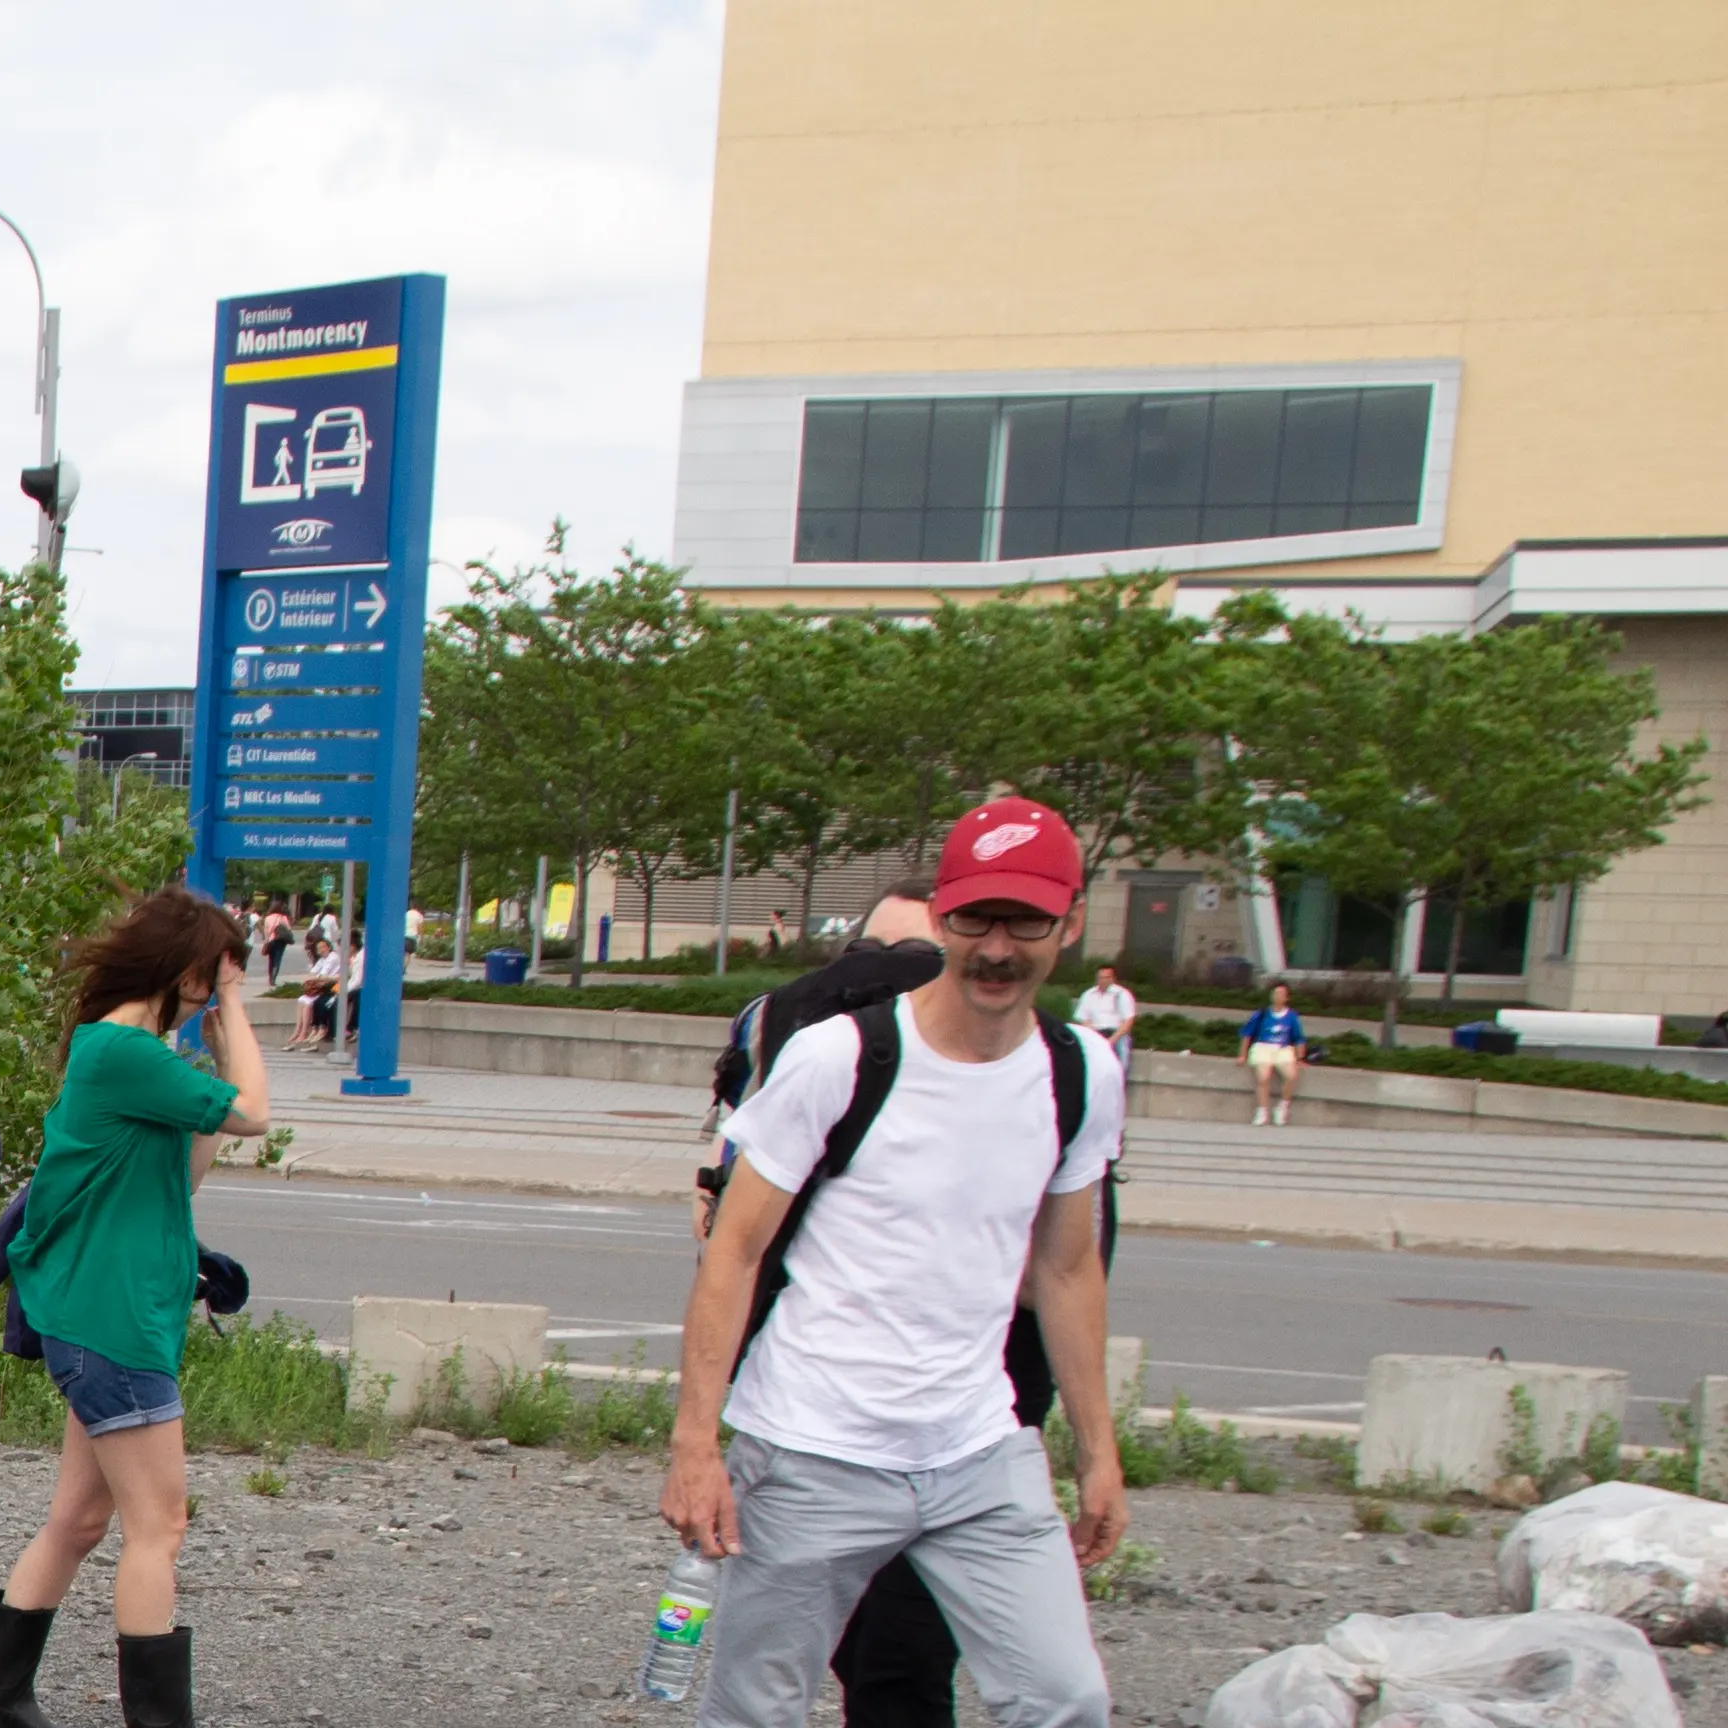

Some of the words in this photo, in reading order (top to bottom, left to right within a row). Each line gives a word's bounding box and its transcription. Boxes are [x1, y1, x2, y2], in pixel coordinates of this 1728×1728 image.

[238, 304, 293, 326] Terminus
[236, 320, 368, 356] Montmorency
[280, 589, 337, 607] Extérieur
[279, 611, 335, 628] Intérieur
[276, 663, 300, 677] STM
[246, 748, 261, 761] CIT
[263, 747, 317, 761] Laurentides
[266, 790, 282, 804] Les
[284, 790, 321, 804] Moulins
[264, 836, 277, 847] rue
[279, 834, 348, 848] Lucien-Paiement
